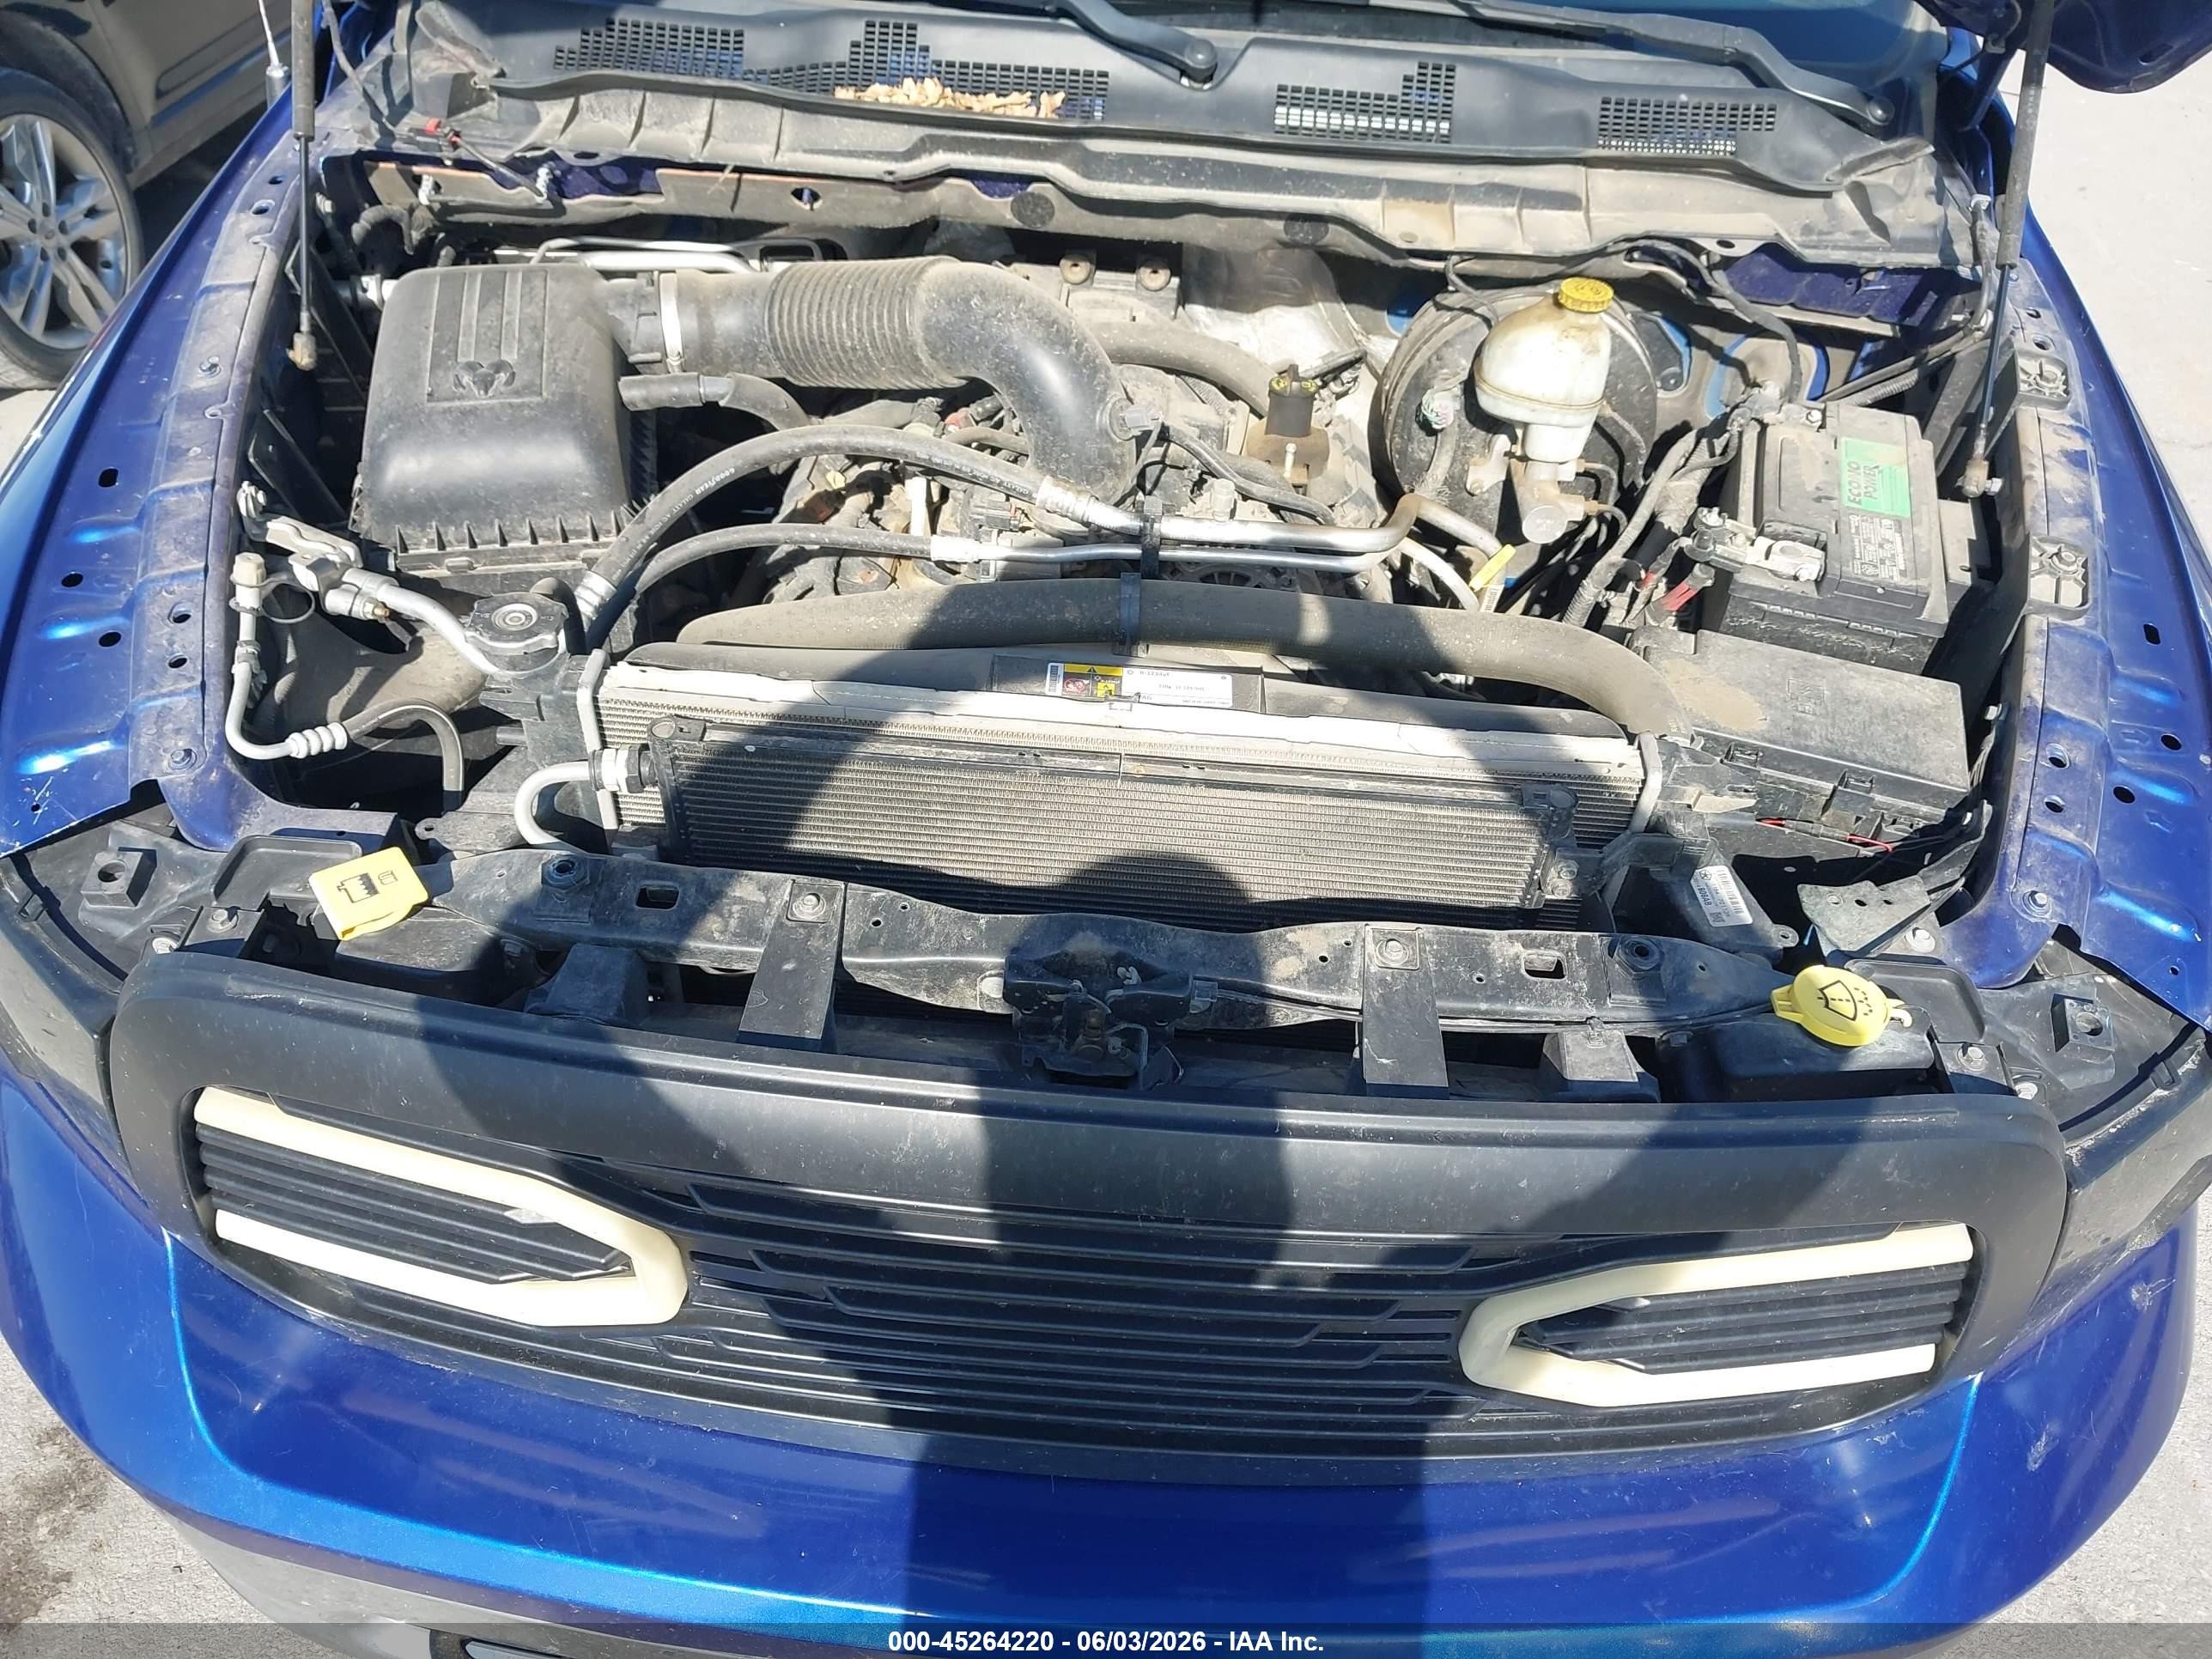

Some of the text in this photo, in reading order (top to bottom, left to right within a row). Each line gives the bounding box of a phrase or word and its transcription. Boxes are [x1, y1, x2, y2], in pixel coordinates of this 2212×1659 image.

[695, 467, 736, 495] GOODYEAR
[1847, 460, 1863, 505] ECONO
[1863, 465, 1880, 500] POWER
